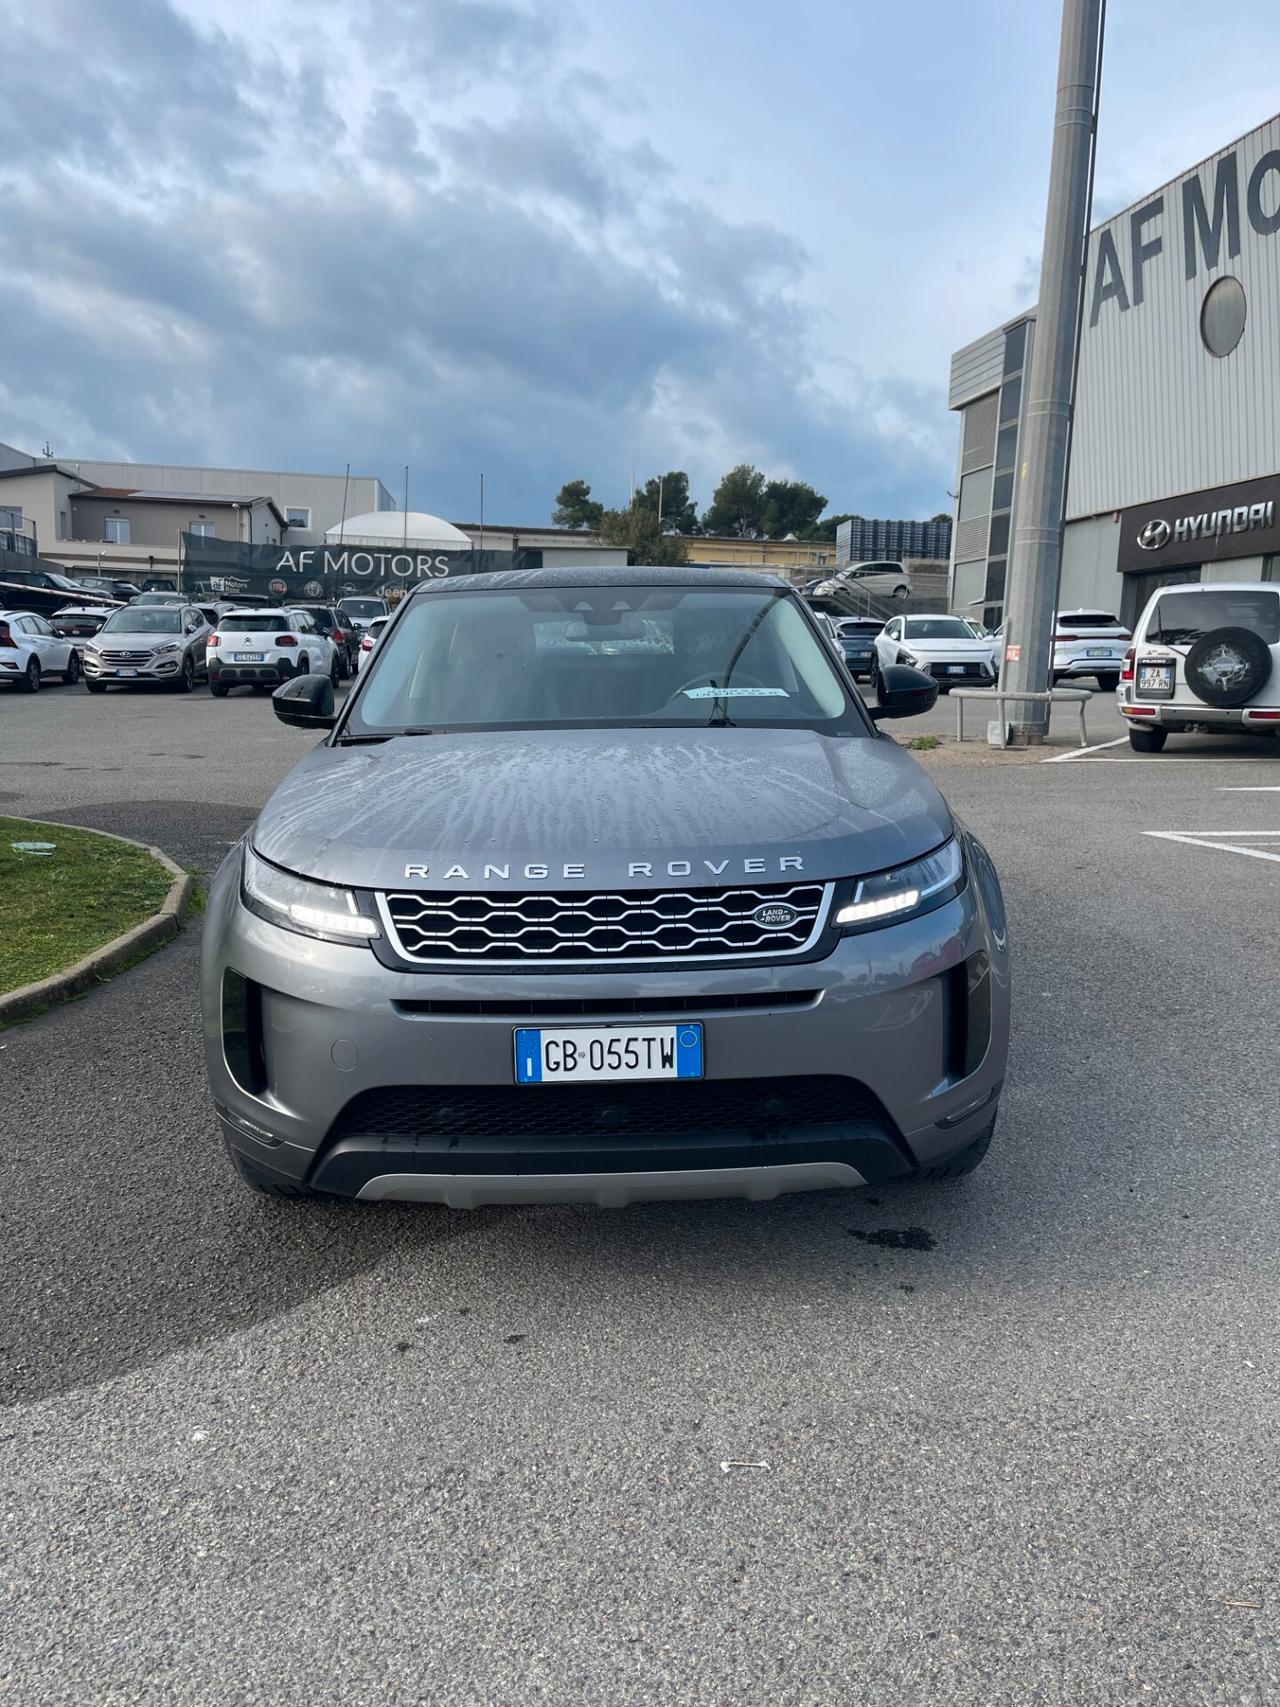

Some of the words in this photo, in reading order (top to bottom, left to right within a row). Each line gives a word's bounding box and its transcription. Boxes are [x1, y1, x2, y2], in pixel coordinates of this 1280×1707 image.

[1089, 195, 1164, 329] AF
[1174, 501, 1273, 542] HYUNDAI
[276, 551, 314, 573] AF
[324, 551, 449, 578] MOTORS
[225, 580, 248, 589] Motors
[1141, 679, 1156, 688] 997
[1158, 680, 1169, 688] RN
[1150, 668, 1161, 678] ZA
[404, 863, 585, 879] RANGE
[628, 856, 804, 877] ROVER
[545, 1040, 577, 1072] GB
[589, 1037, 675, 1071] 055TW
